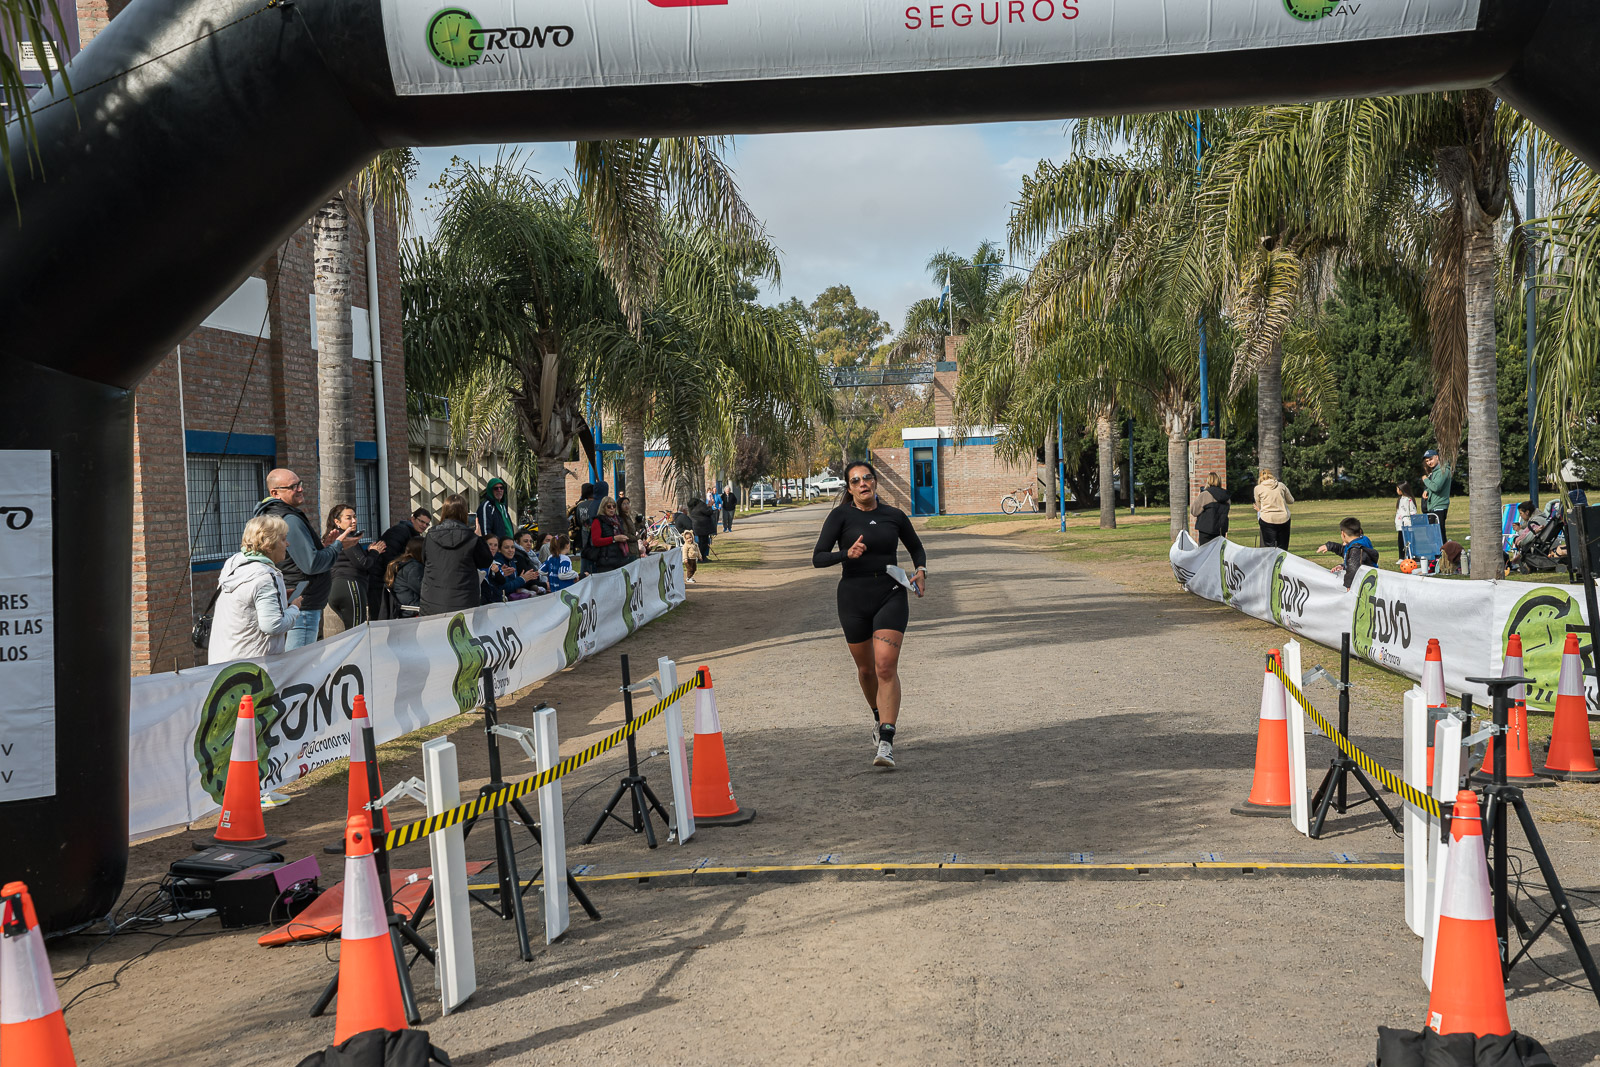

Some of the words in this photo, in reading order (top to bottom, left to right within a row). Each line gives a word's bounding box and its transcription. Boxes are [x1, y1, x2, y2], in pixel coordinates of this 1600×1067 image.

[905, 0, 1080, 30] SEGUROS
[1321, 3, 1361, 17] RAV
[468, 25, 574, 51] CRONO
[468, 53, 505, 65] RAV
[14, 618, 43, 635] LAS
[0, 645, 28, 662] LOS
